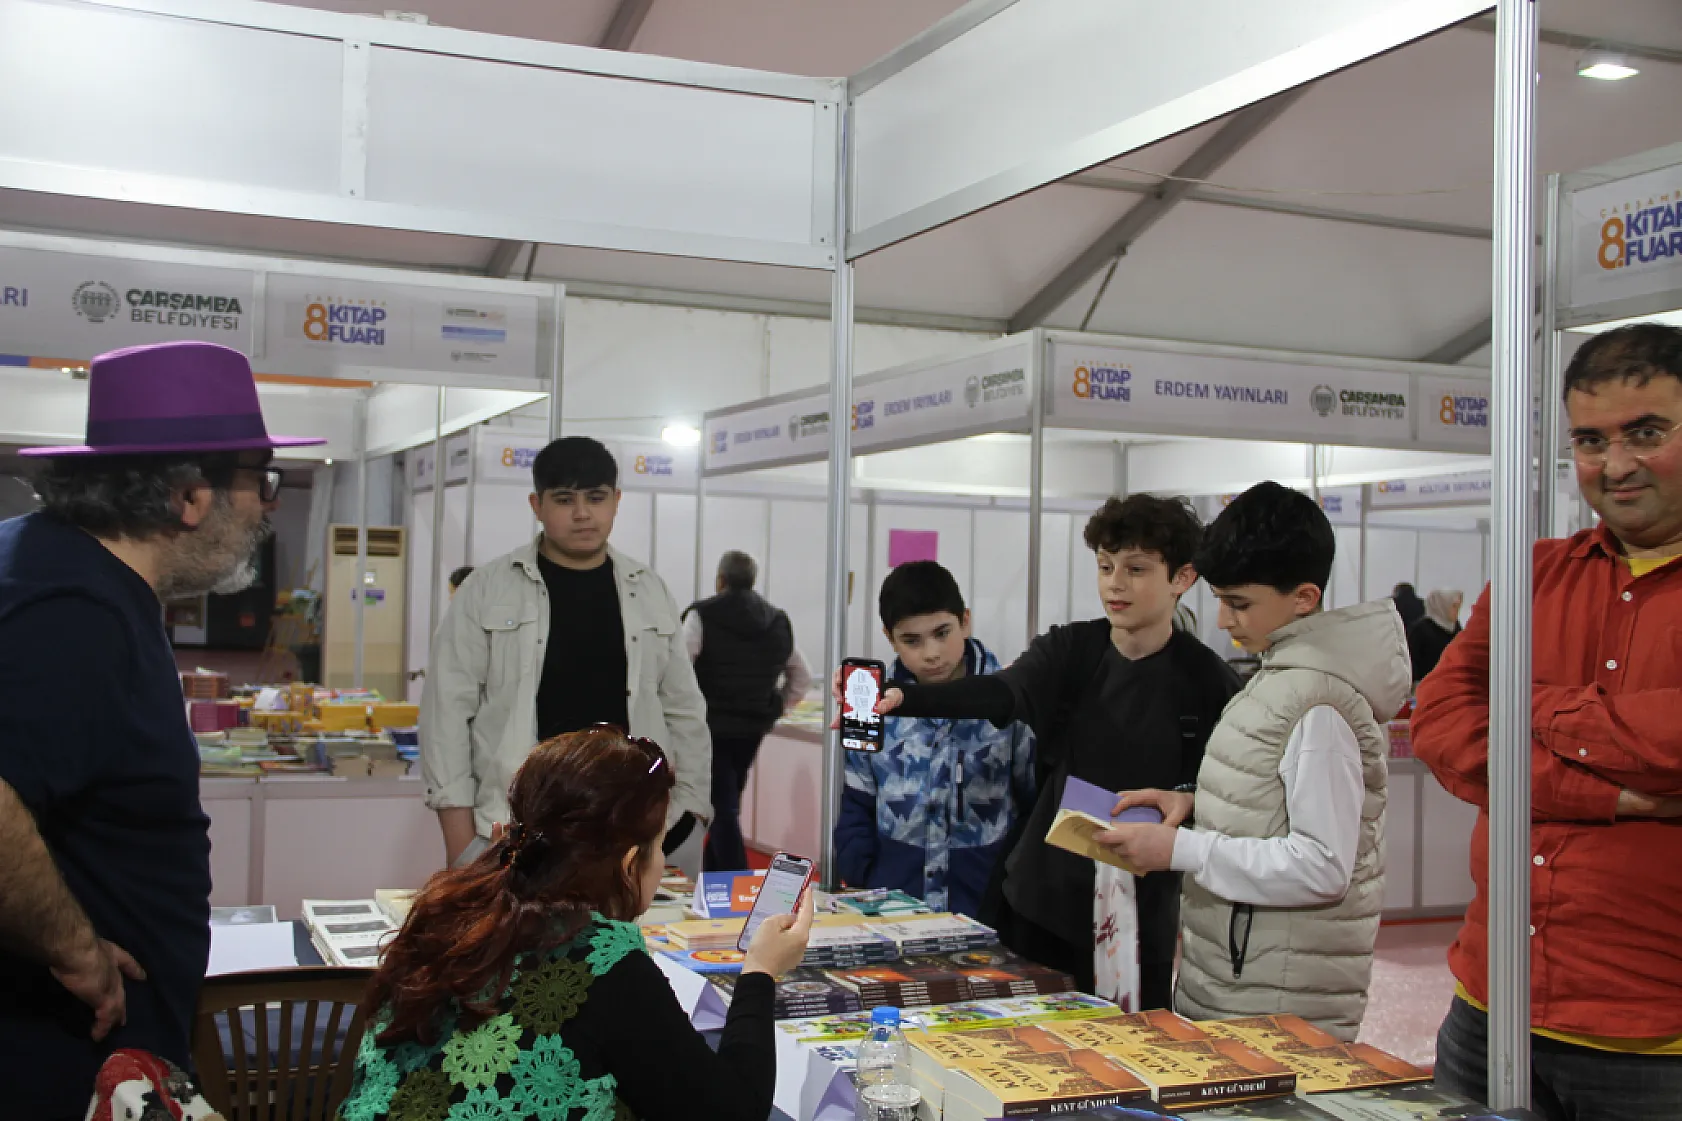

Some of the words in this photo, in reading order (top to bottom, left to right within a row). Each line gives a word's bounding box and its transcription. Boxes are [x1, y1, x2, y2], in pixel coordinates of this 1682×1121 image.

[131, 308, 239, 331] BELEDİYESİ
[328, 304, 386, 325] KİTAP
[328, 324, 385, 346] FUARI
[1090, 384, 1131, 402] FUARI
[1155, 380, 1209, 399] ERDEM
[1214, 385, 1289, 405] YAYINLARI
